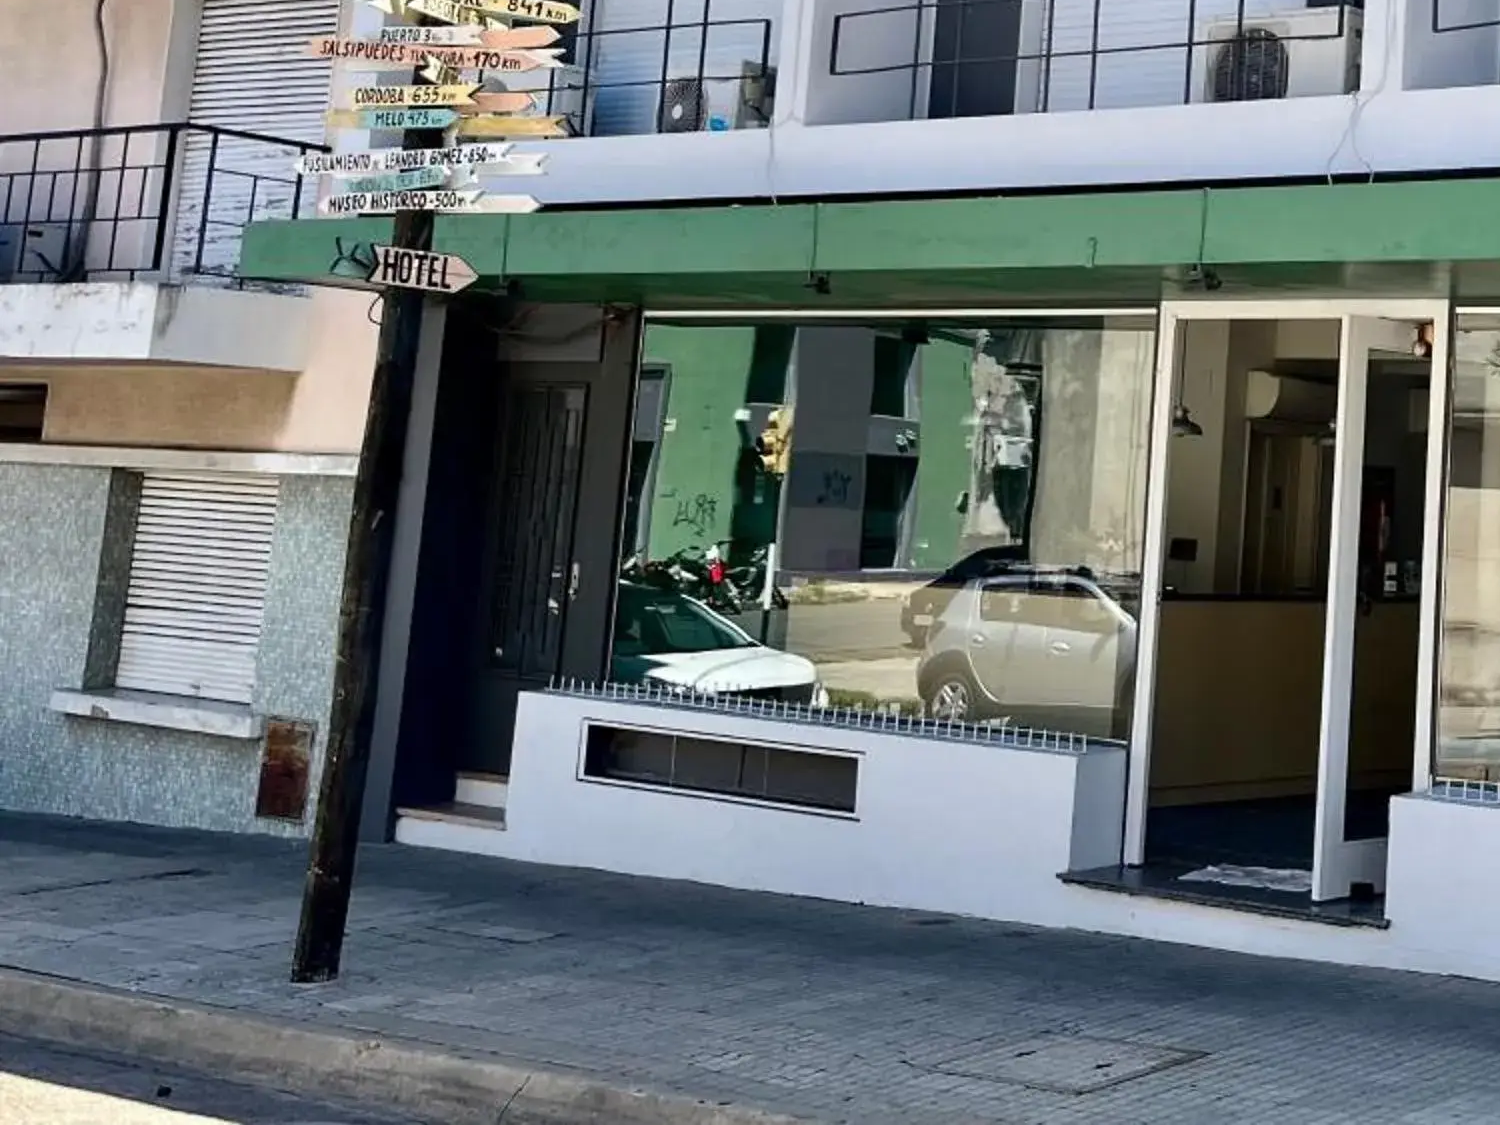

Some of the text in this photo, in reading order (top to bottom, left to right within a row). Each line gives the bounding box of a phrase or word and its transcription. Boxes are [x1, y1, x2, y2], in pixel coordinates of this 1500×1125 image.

[544, 9, 568, 22] km
[380, 28, 421, 44] PUERTO
[424, 28, 432, 42] 3
[319, 39, 405, 62] SALSIPUEDES
[472, 51, 500, 68] 170
[501, 57, 521, 70] km
[354, 87, 405, 104] CORDOBA
[411, 86, 440, 103] 655
[374, 112, 406, 125] MELO
[303, 154, 371, 173] FUSILAMIENTO
[328, 193, 367, 212] MUSEO
[371, 191, 427, 210] HISTORICO
[381, 248, 451, 290] HOTEL
